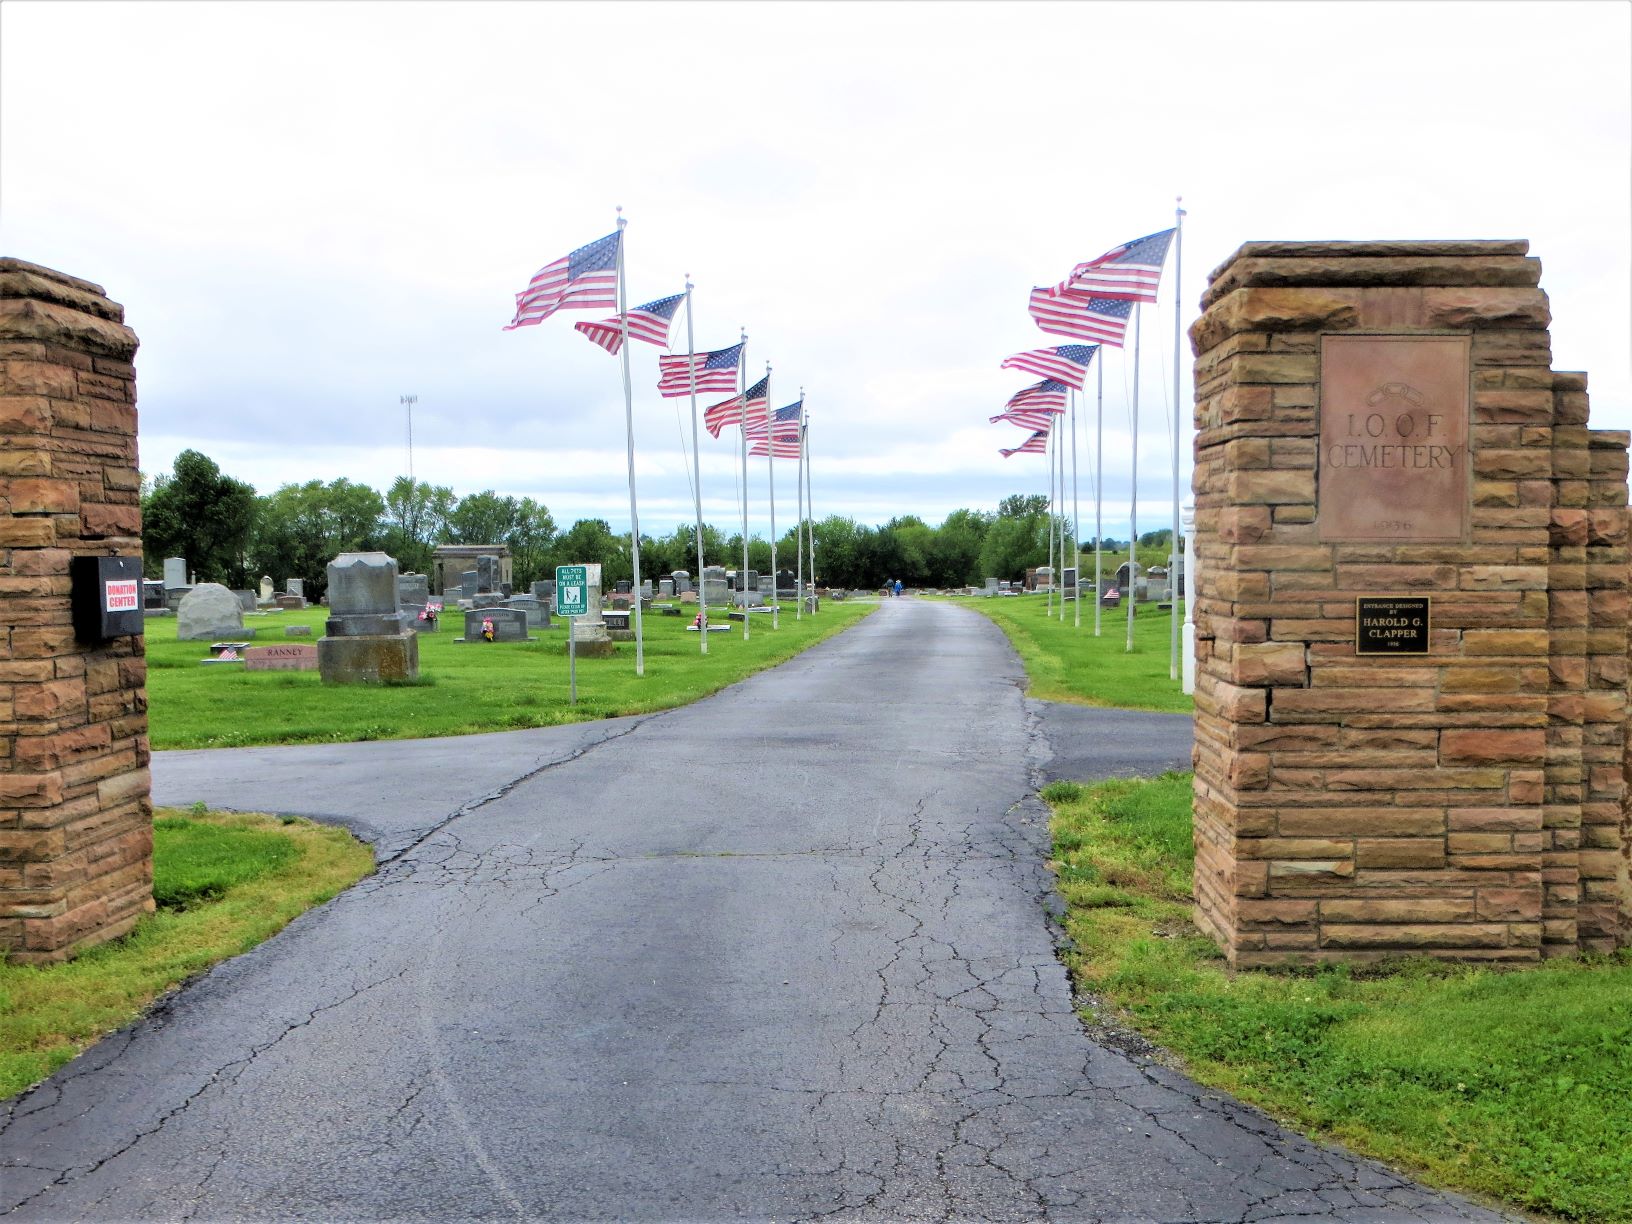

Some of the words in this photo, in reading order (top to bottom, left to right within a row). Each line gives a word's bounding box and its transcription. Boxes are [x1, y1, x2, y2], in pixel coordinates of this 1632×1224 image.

[1327, 444, 1462, 469] CEMETERY
[107, 584, 136, 596] DONATION
[110, 596, 136, 608] CENTER
[1363, 617, 1409, 627] HAROLD
[1412, 617, 1424, 627] G.
[1368, 629, 1418, 638] CLAPPER
[267, 648, 303, 657] RANNEY
